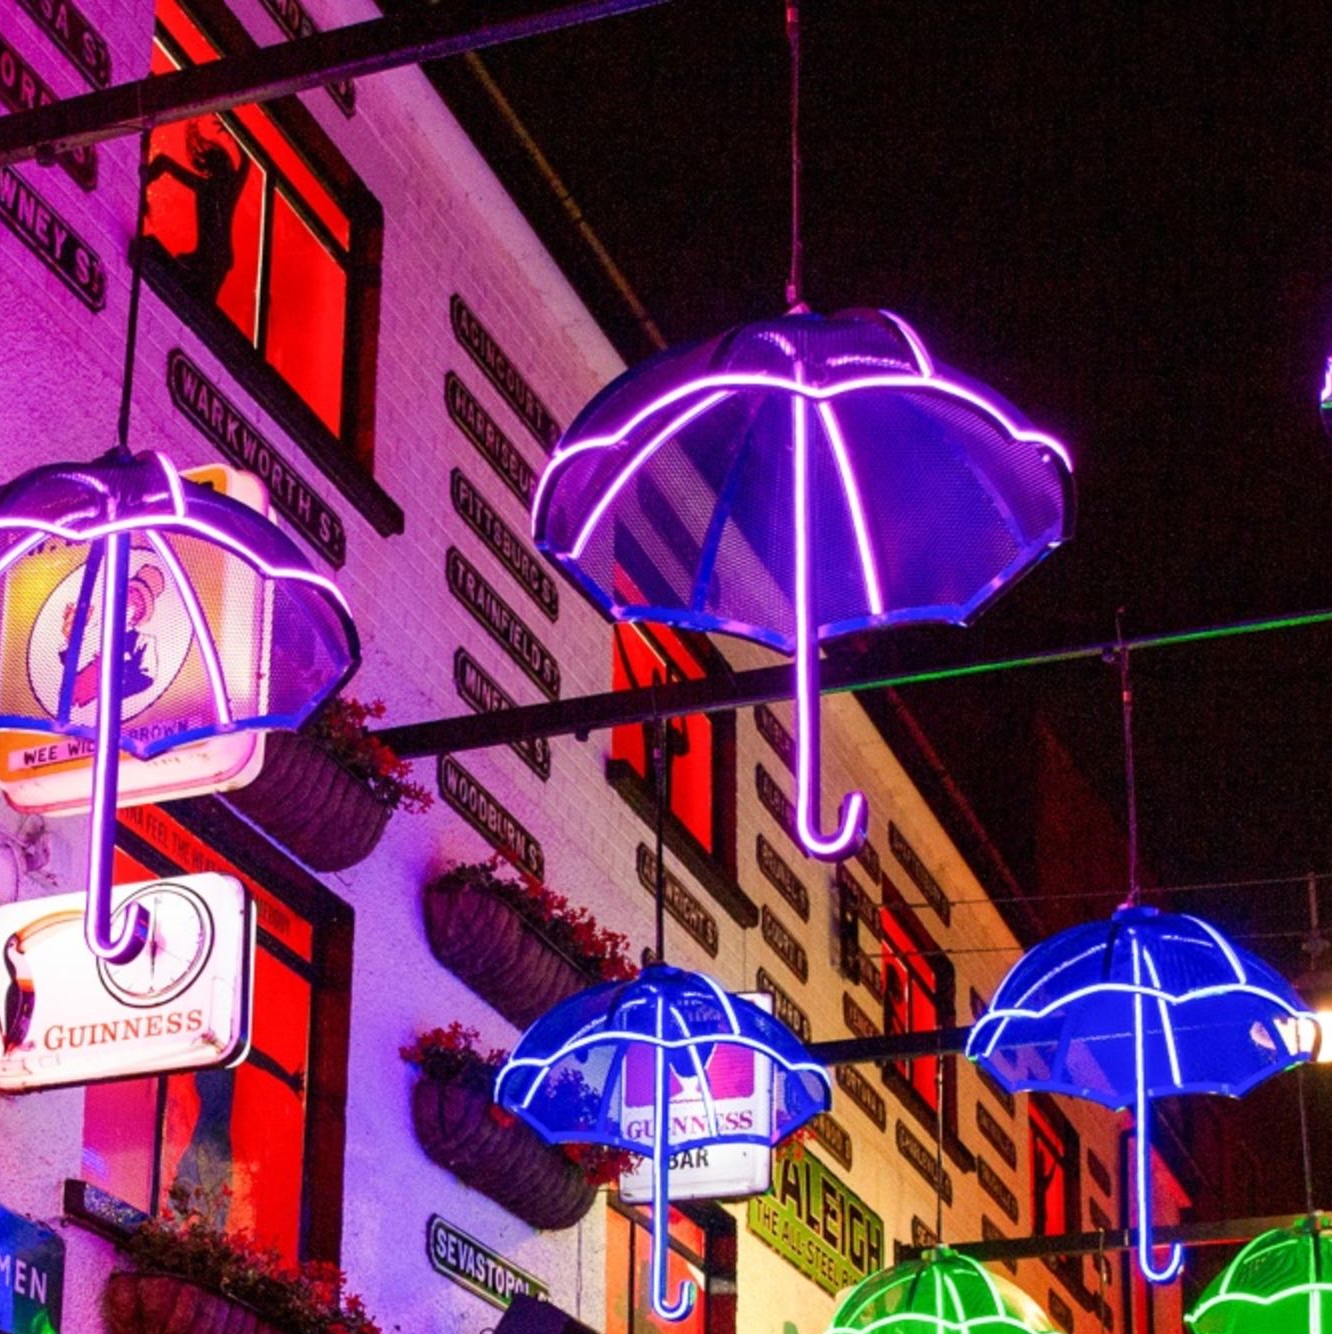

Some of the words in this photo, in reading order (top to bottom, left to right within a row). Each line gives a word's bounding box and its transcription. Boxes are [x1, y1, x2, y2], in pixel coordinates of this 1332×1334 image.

[180, 363, 313, 521] WARKWORTH
[23, 744, 58, 766] WEE
[43, 1008, 205, 1052] GUINNESS
[627, 1111, 753, 1140] GUNNSS
[775, 1158, 882, 1275] ALEIGH
